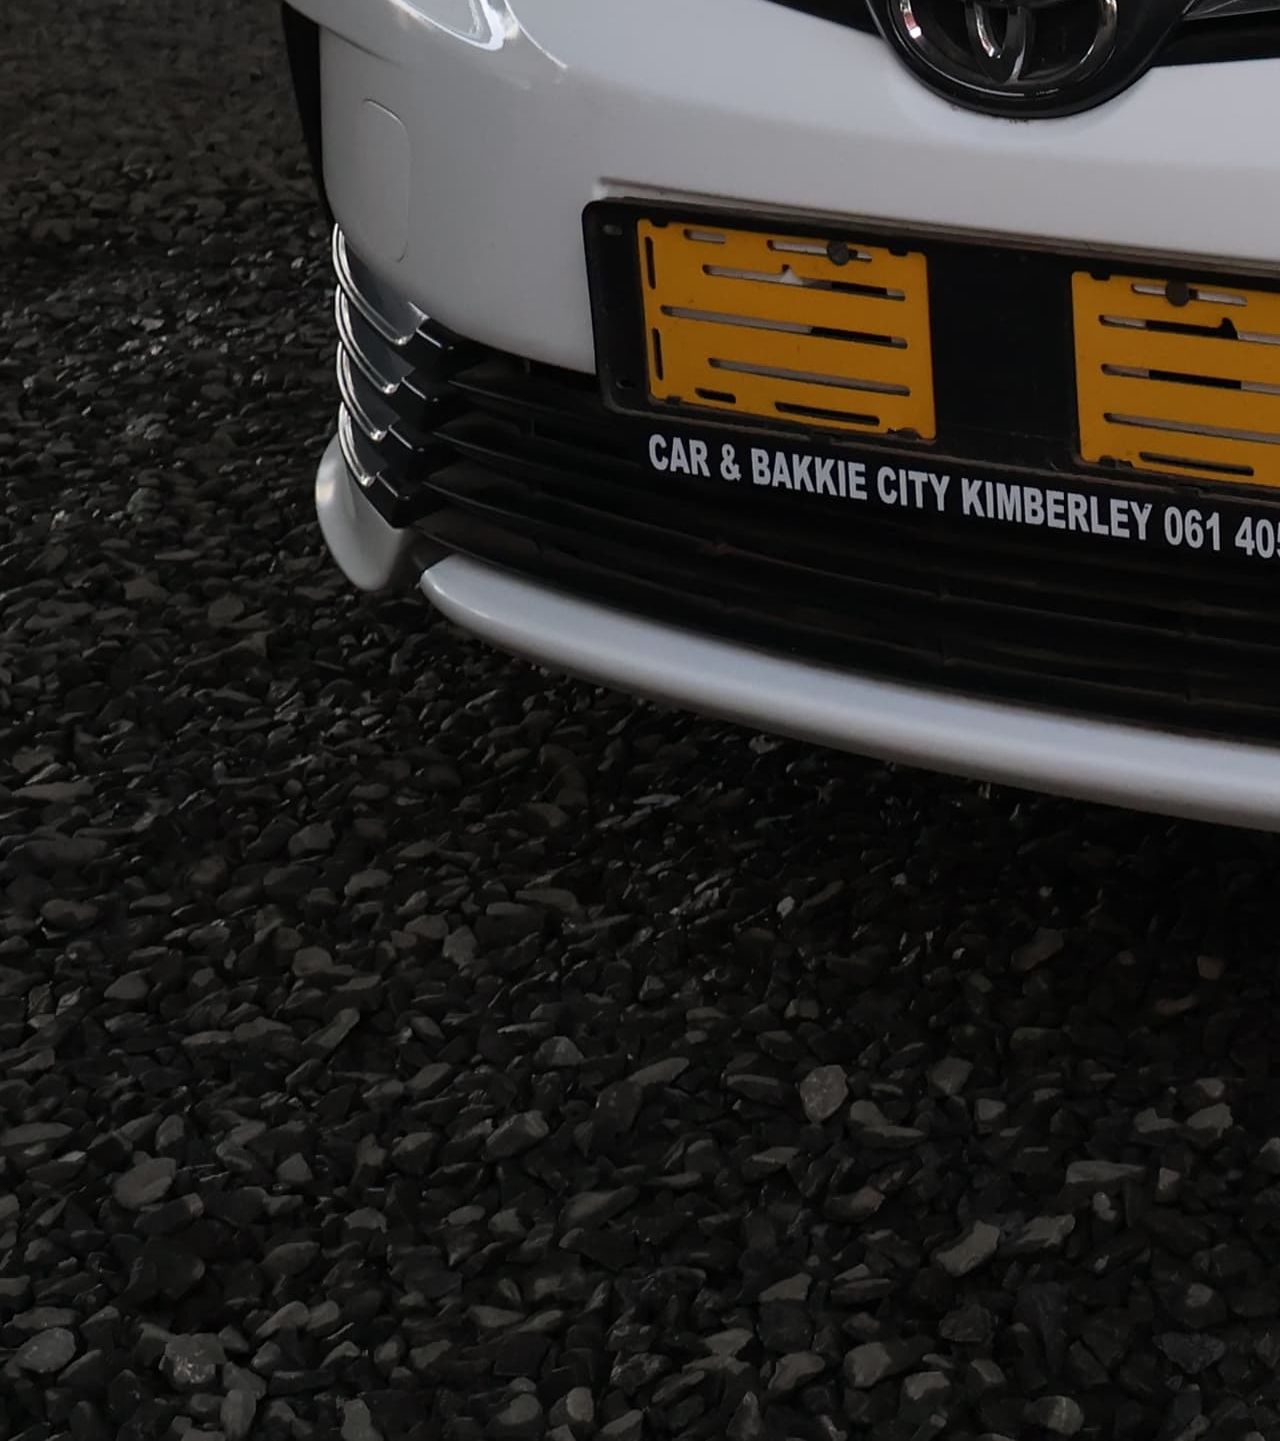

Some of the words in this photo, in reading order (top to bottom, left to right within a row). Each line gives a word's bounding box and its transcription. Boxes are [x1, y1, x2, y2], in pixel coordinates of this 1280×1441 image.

[649, 433, 711, 477] CAR
[720, 443, 742, 482] &
[751, 447, 868, 500] BAKKIE
[877, 465, 950, 512] CITY
[961, 477, 1153, 541] KIMBERLEY
[1164, 506, 1221, 551] 061
